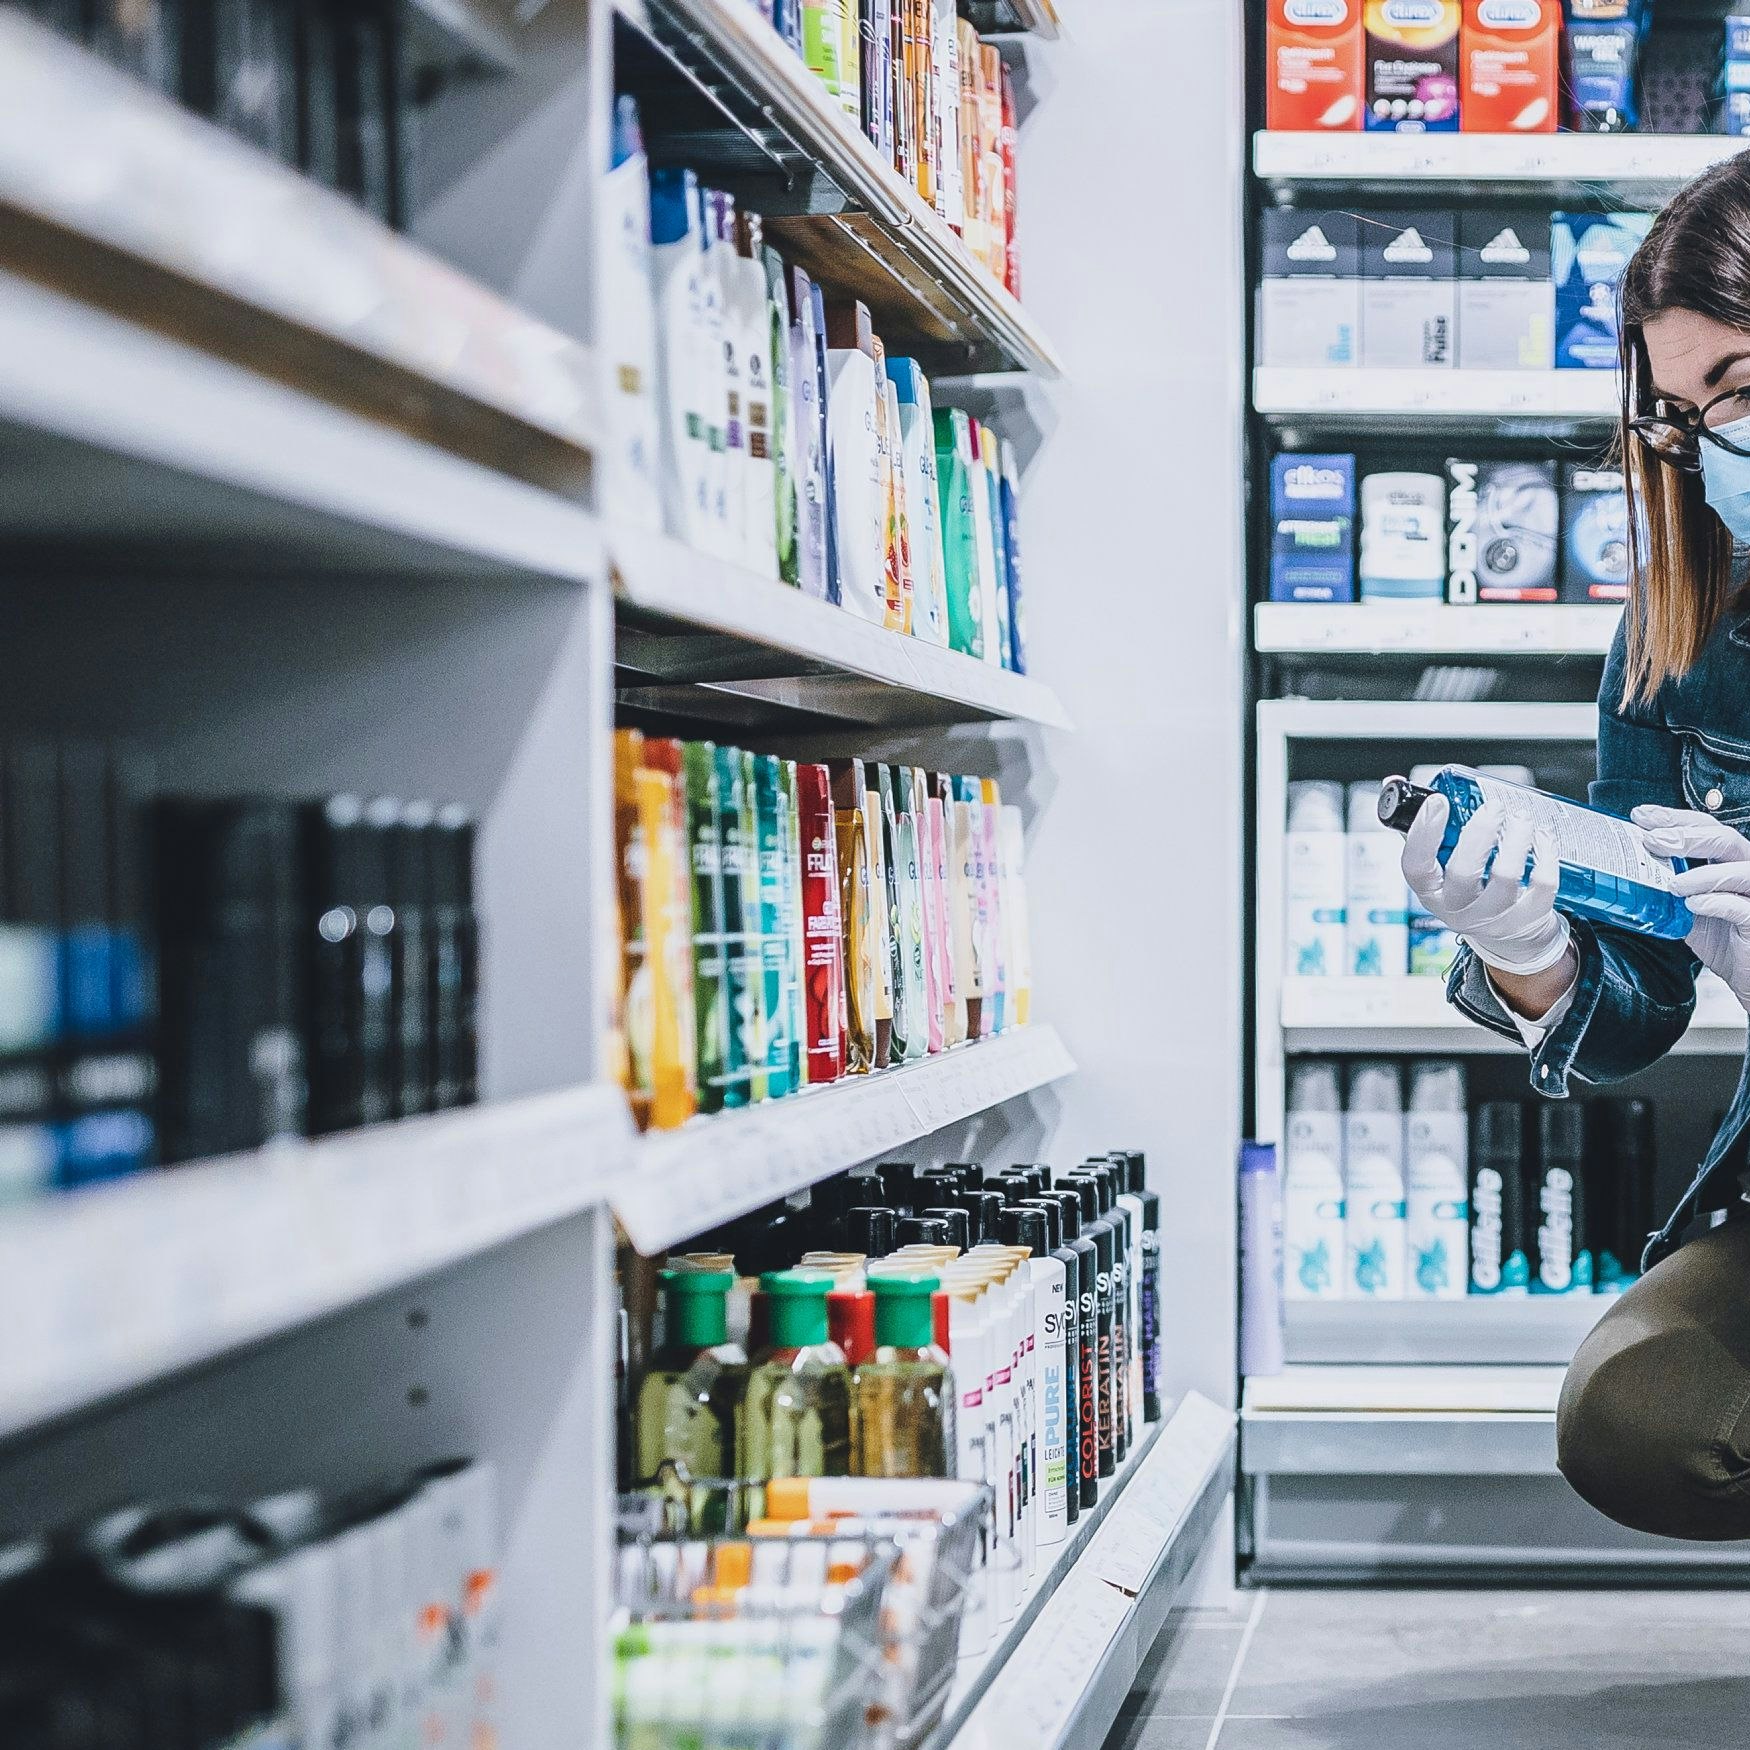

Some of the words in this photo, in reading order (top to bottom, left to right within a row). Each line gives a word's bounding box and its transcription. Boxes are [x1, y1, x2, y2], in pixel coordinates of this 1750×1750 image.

[1045, 1366, 1060, 1446] PURE
[1081, 1344, 1094, 1479] COLORIST
[1099, 1335, 1111, 1450] KERATIN
